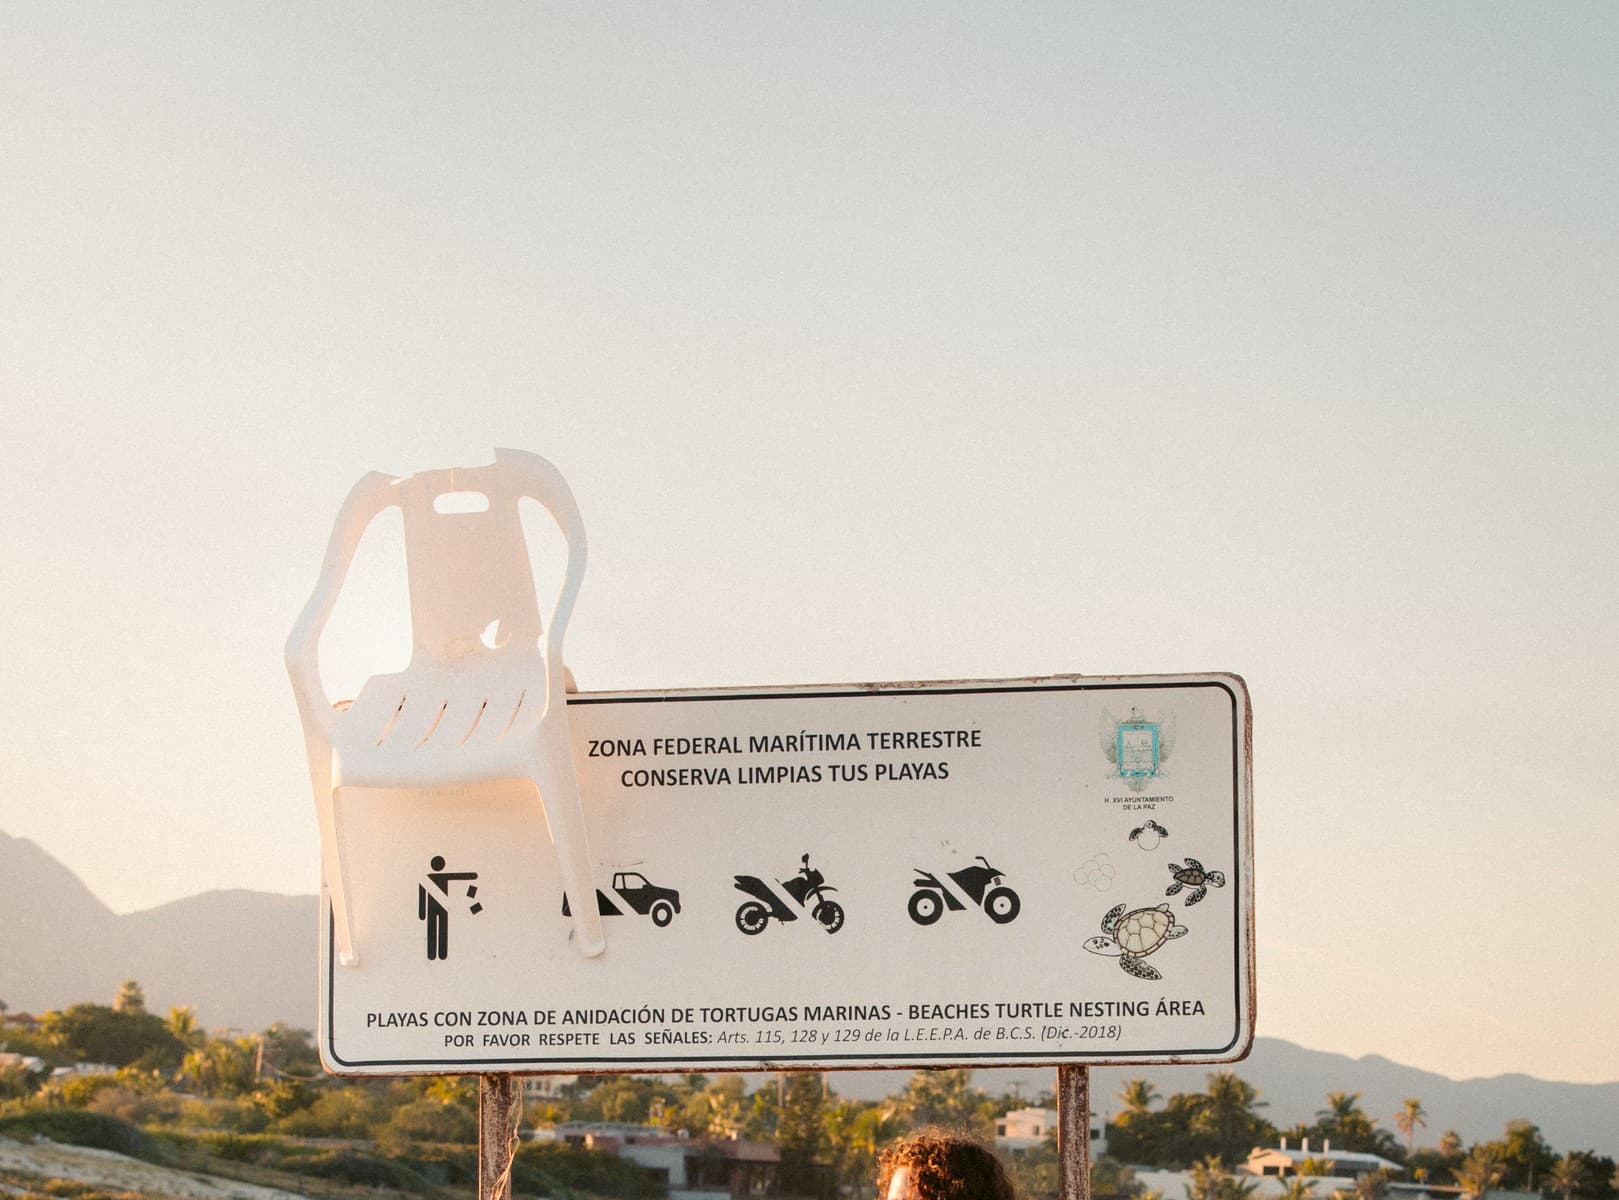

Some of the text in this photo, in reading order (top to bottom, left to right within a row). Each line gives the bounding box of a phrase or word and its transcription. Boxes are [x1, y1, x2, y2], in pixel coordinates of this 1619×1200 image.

[588, 730, 982, 758] ZONA FEDERAL MARÍTIMA TERRESTRE
[620, 761, 950, 788] CONSERVA LIMPIAS TUS PLAYAS
[366, 1011, 429, 1028] PLAYAS
[433, 1011, 472, 1027] CON
[476, 1010, 529, 1026] ZONA
[533, 1009, 557, 1025] DE
[561, 1004, 665, 1025] ANIDACIÓN
[671, 1008, 695, 1024] DE
[699, 1006, 799, 1023] TORTUGAS
[803, 1004, 892, 1022] MARINAS
[908, 1003, 990, 1020] BEACHES
[994, 1002, 1064, 1019] TURTLE
[1069, 1001, 1150, 1017] NESTING
[1155, 996, 1206, 1017] ÁREA
[444, 1024, 1122, 1048] POR FAVOR RESPETE LAS SEÑALES: Arts. 115, 128 y 129 de la L.E.E.P.A. de B.C.S. (Dic.-2018)
